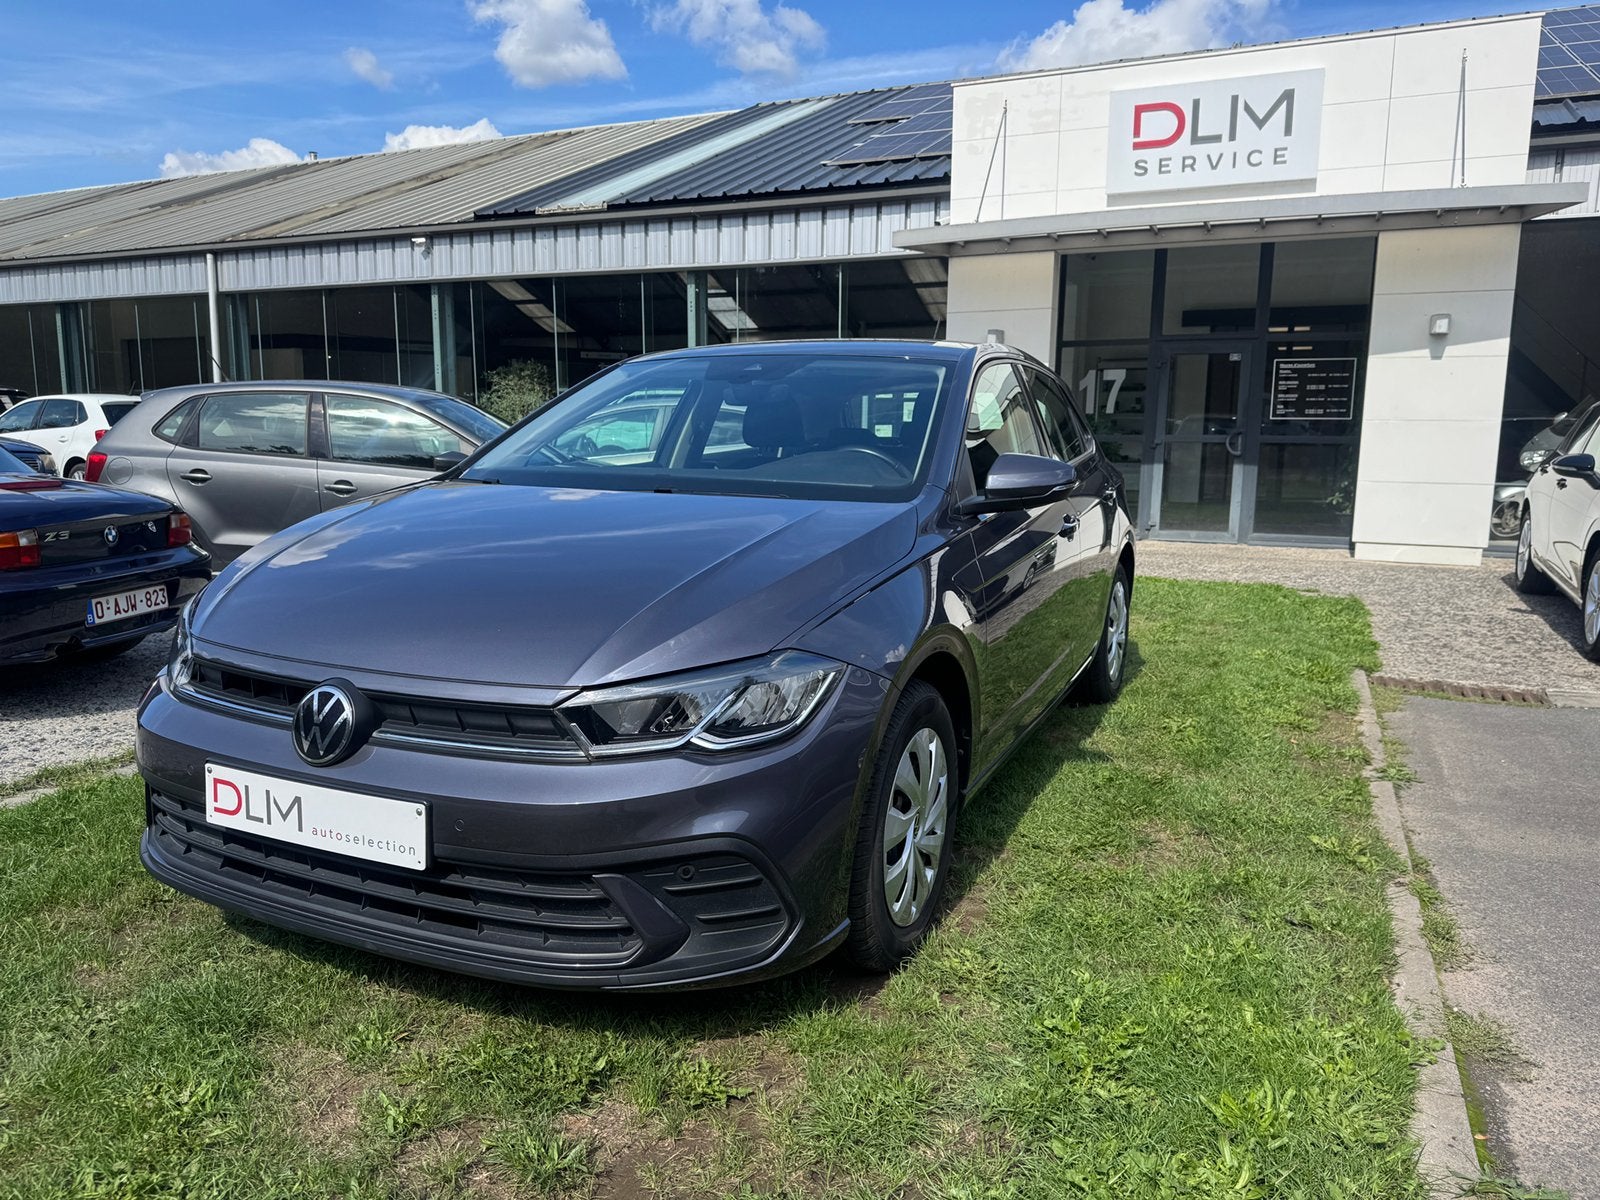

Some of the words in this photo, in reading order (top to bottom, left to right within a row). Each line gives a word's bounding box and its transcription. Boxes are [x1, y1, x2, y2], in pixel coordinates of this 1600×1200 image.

[1133, 146, 1289, 177] SERVICE
[1079, 368, 1127, 415] 17
[43, 530, 70, 543] Z3
[87, 614, 94, 623] B
[311, 825, 417, 857] autoselection
